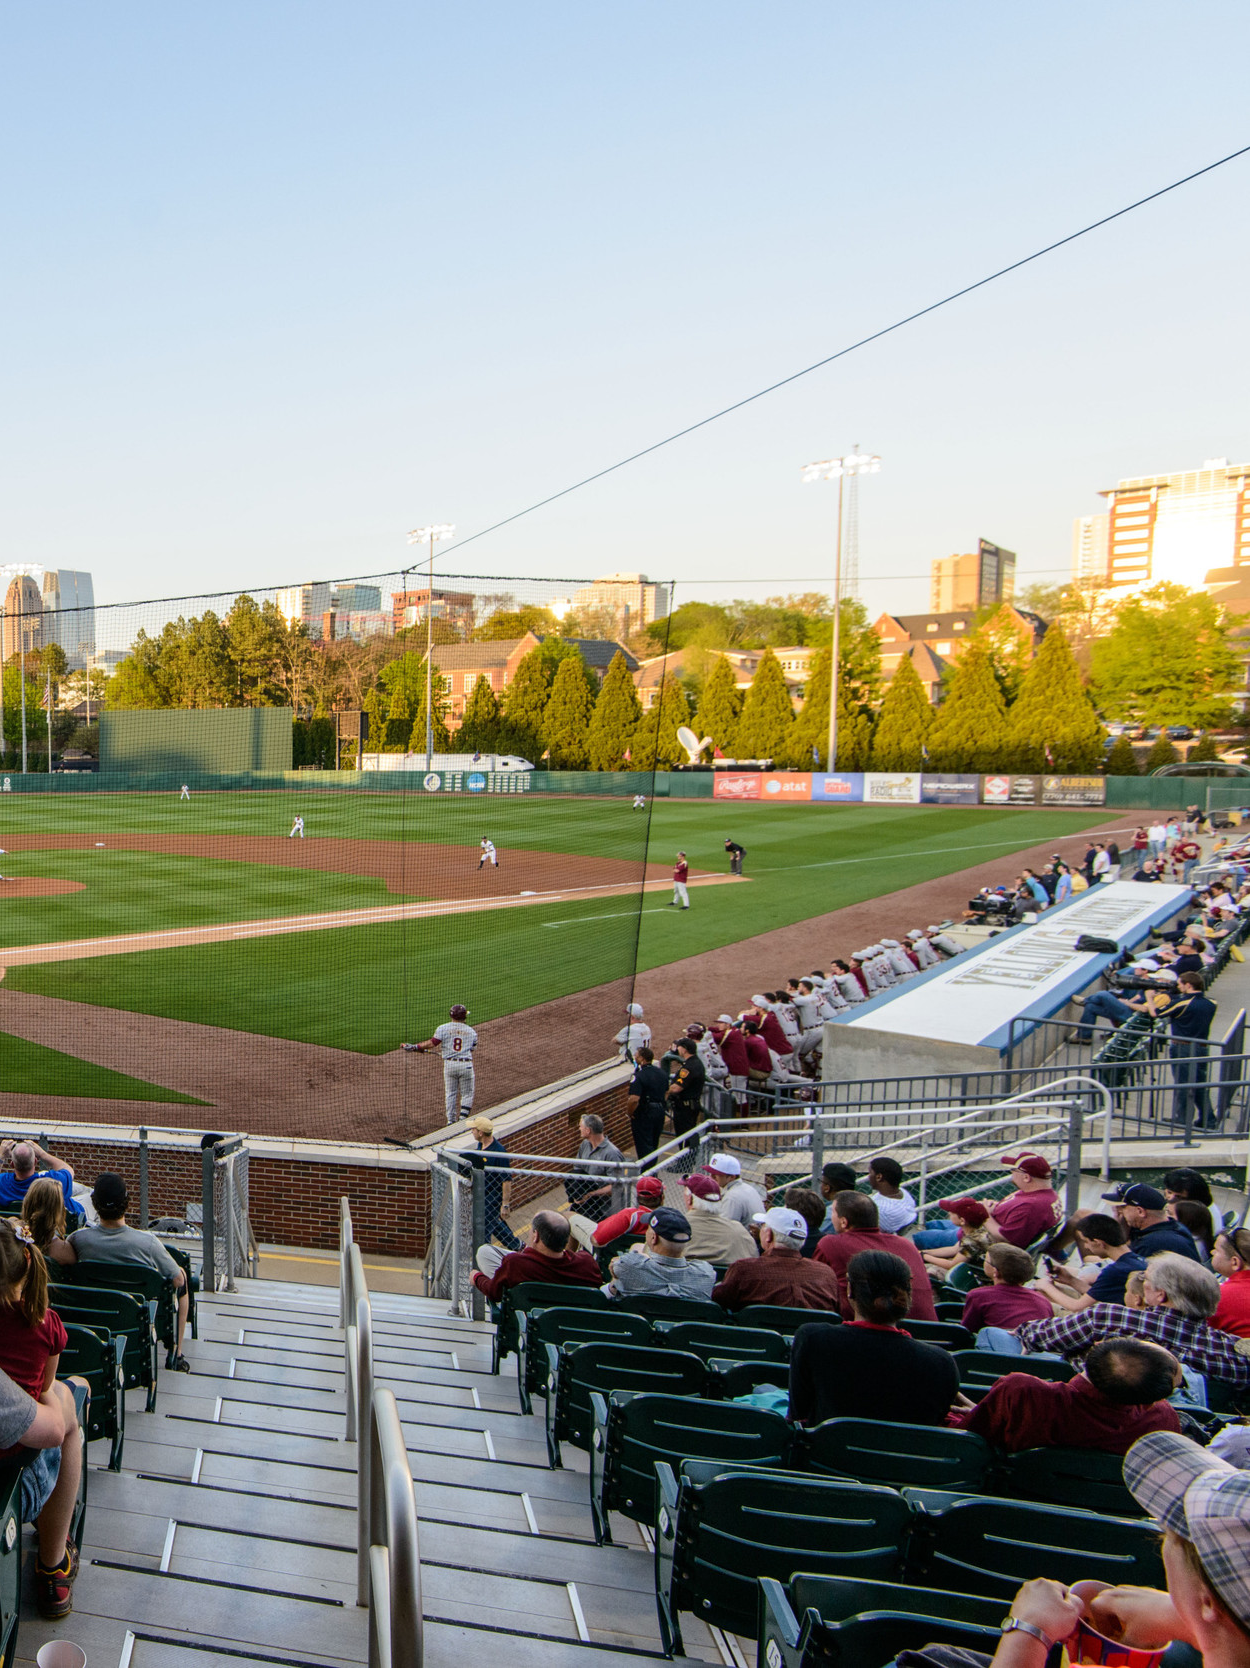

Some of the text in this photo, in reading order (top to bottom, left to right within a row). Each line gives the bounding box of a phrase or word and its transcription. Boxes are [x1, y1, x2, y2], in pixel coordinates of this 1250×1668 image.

[718, 780, 756, 792] Rawlings
[782, 781, 807, 792] at&t
[453, 1037, 462, 1051] 8
